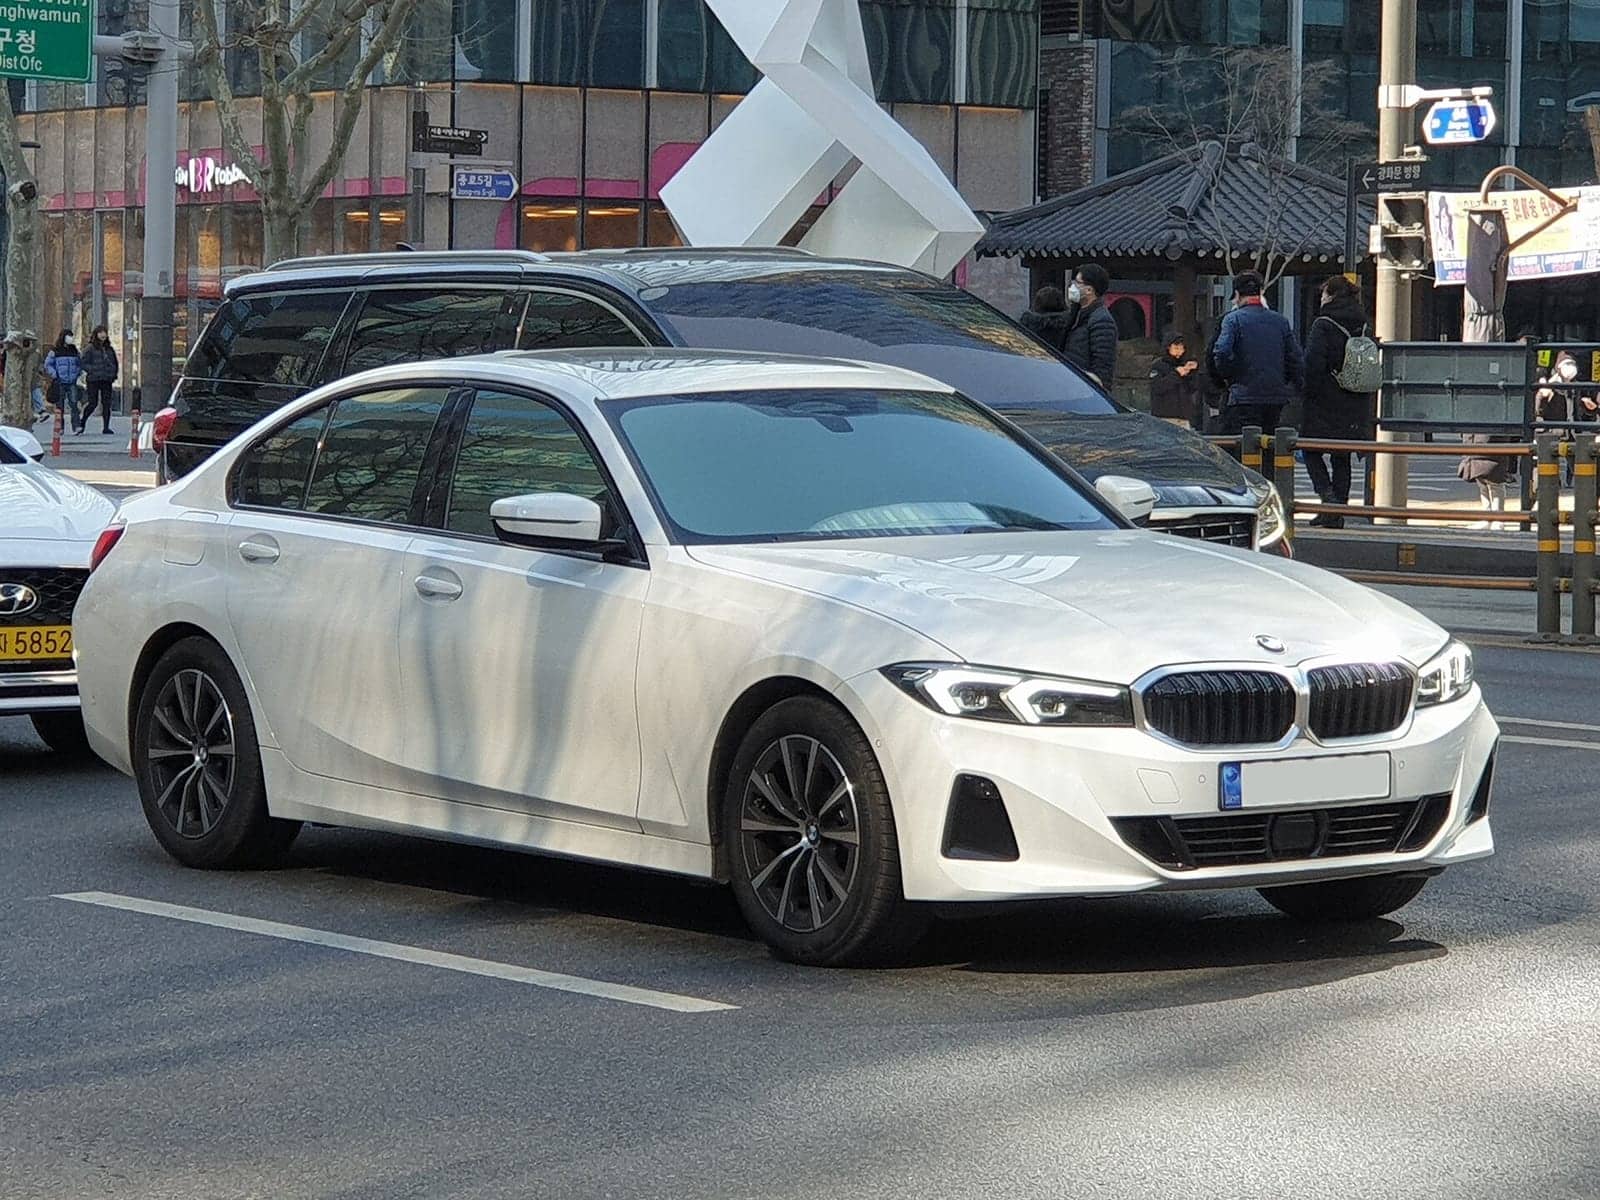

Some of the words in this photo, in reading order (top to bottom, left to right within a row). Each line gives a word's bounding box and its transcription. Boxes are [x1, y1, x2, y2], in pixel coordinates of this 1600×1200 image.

[0, 54, 18, 70] ist
[20, 55, 43, 72] Ofc
[189, 157, 214, 193] BR
[15, 631, 72, 654] 5852
